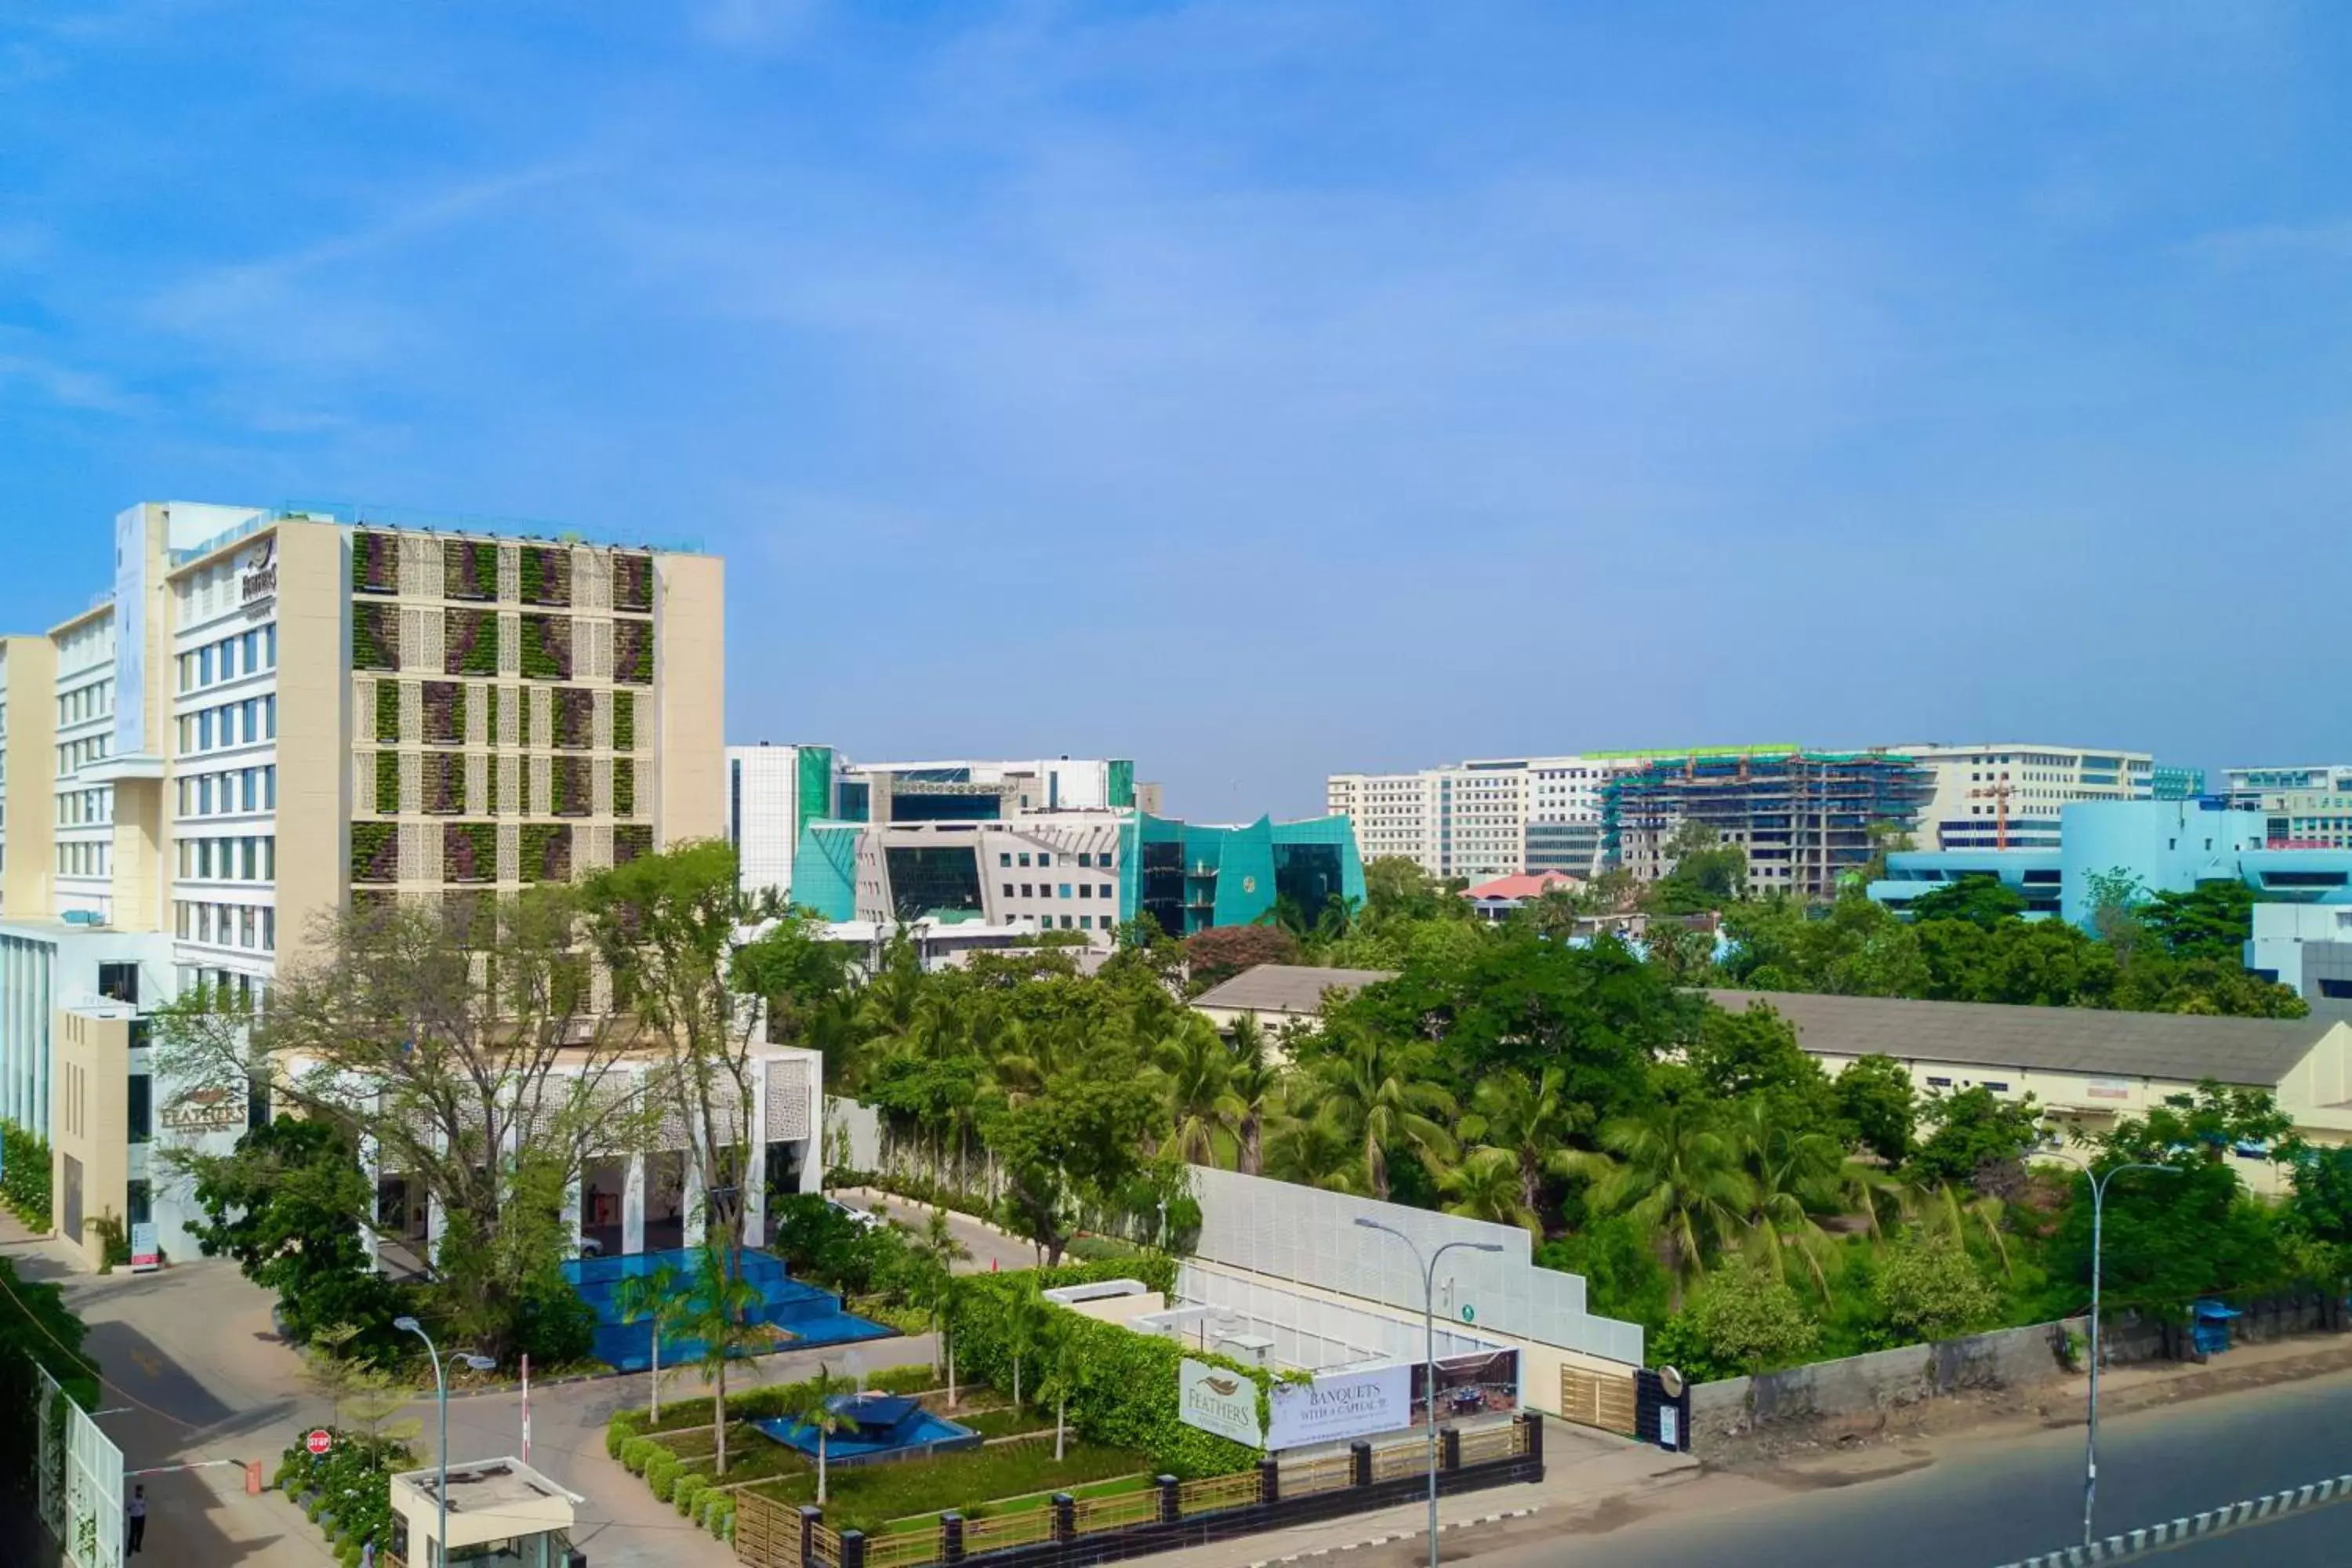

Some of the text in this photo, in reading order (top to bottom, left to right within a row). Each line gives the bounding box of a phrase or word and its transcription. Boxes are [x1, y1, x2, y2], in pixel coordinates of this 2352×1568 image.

[241, 562, 276, 601] FTHS
[1310, 1382, 1381, 1406] BANQUETS
[1188, 1388, 1249, 1426] FEATHERS
[1301, 1406, 1327, 1421] WITH
[310, 1437, 328, 1448] STOP
